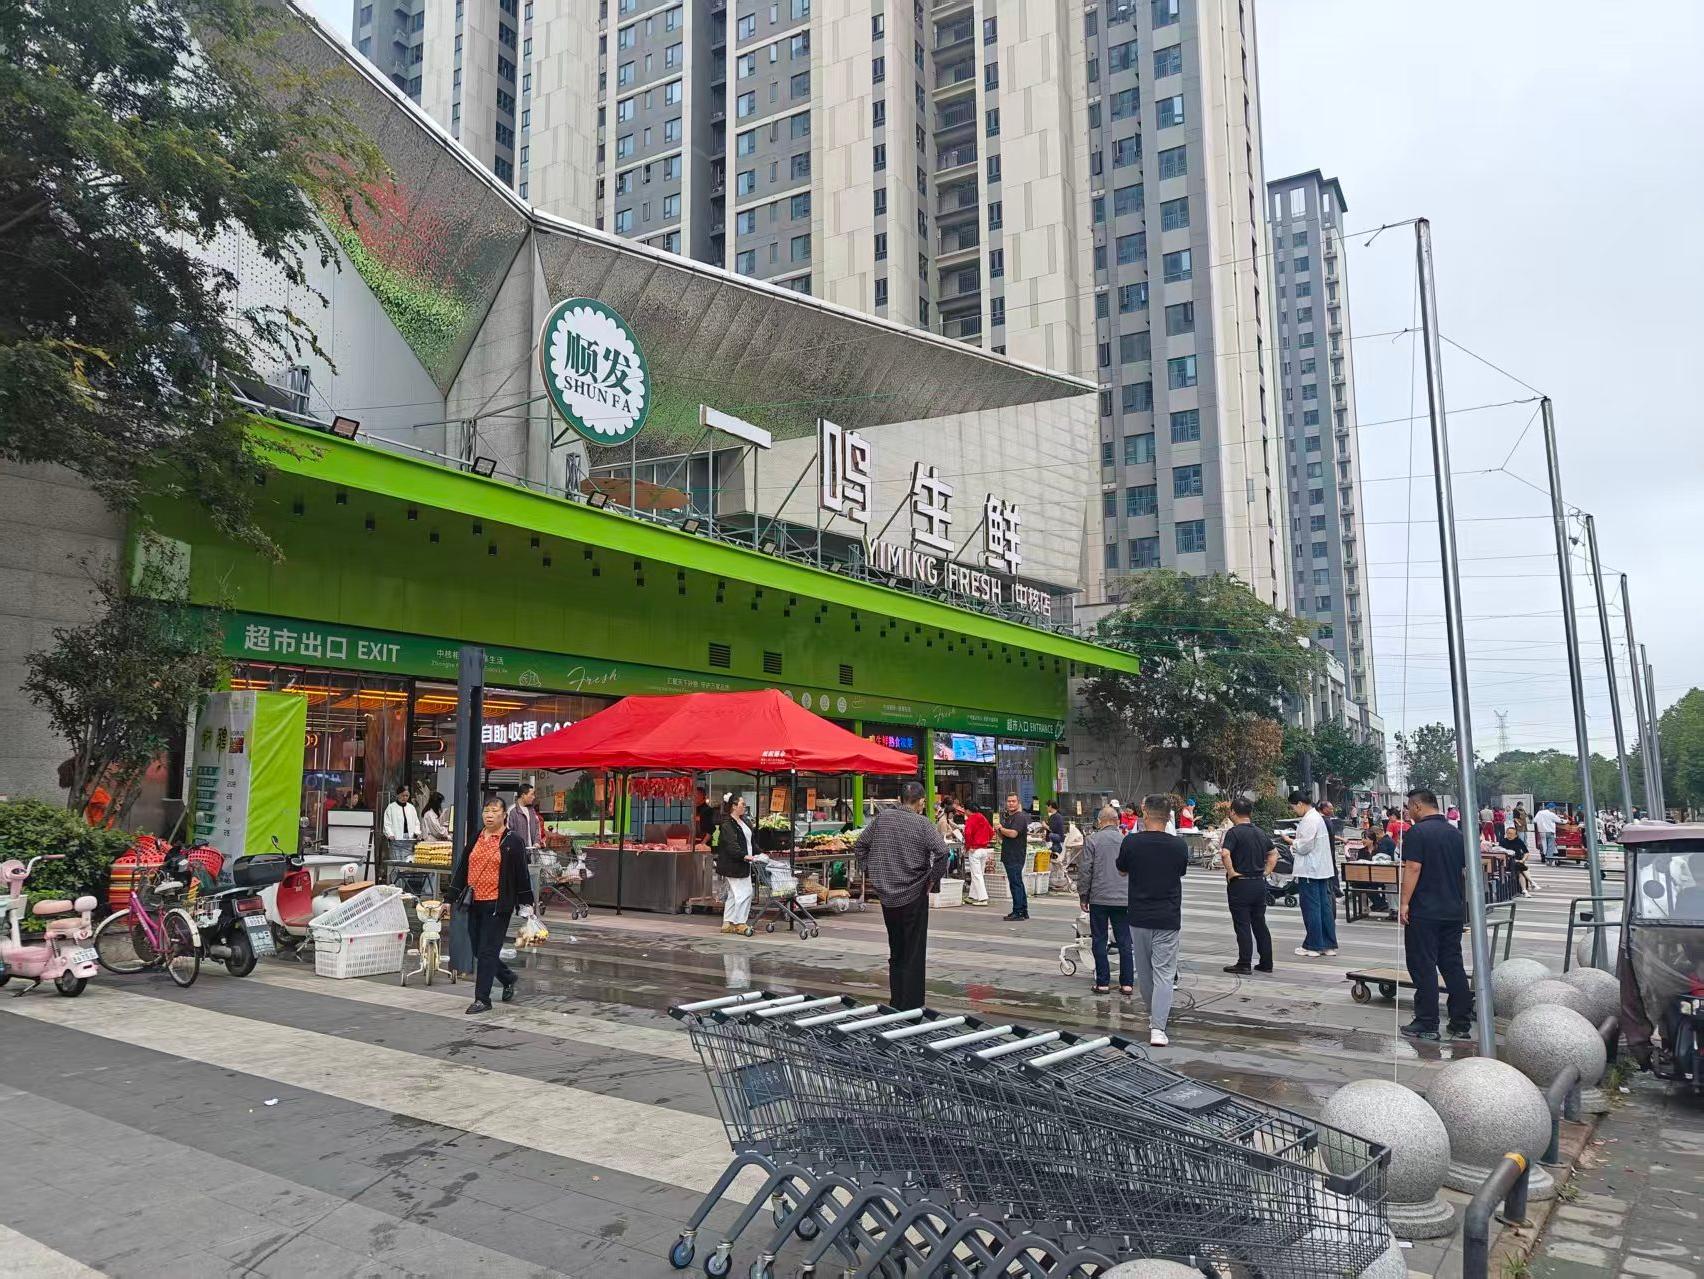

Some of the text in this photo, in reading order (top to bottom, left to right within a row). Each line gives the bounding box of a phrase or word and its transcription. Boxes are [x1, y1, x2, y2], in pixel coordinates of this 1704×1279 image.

[564, 330, 631, 395] 顺发
[564, 375, 631, 413] SHUN FA
[861, 535, 1002, 604] YIMING FRESH
[244, 624, 347, 660] 超市出口
[357, 640, 401, 663] EXIT
[567, 666, 617, 691] Fresh
[482, 721, 538, 743] 自助收银
[1007, 718, 1028, 732] 超市入口
